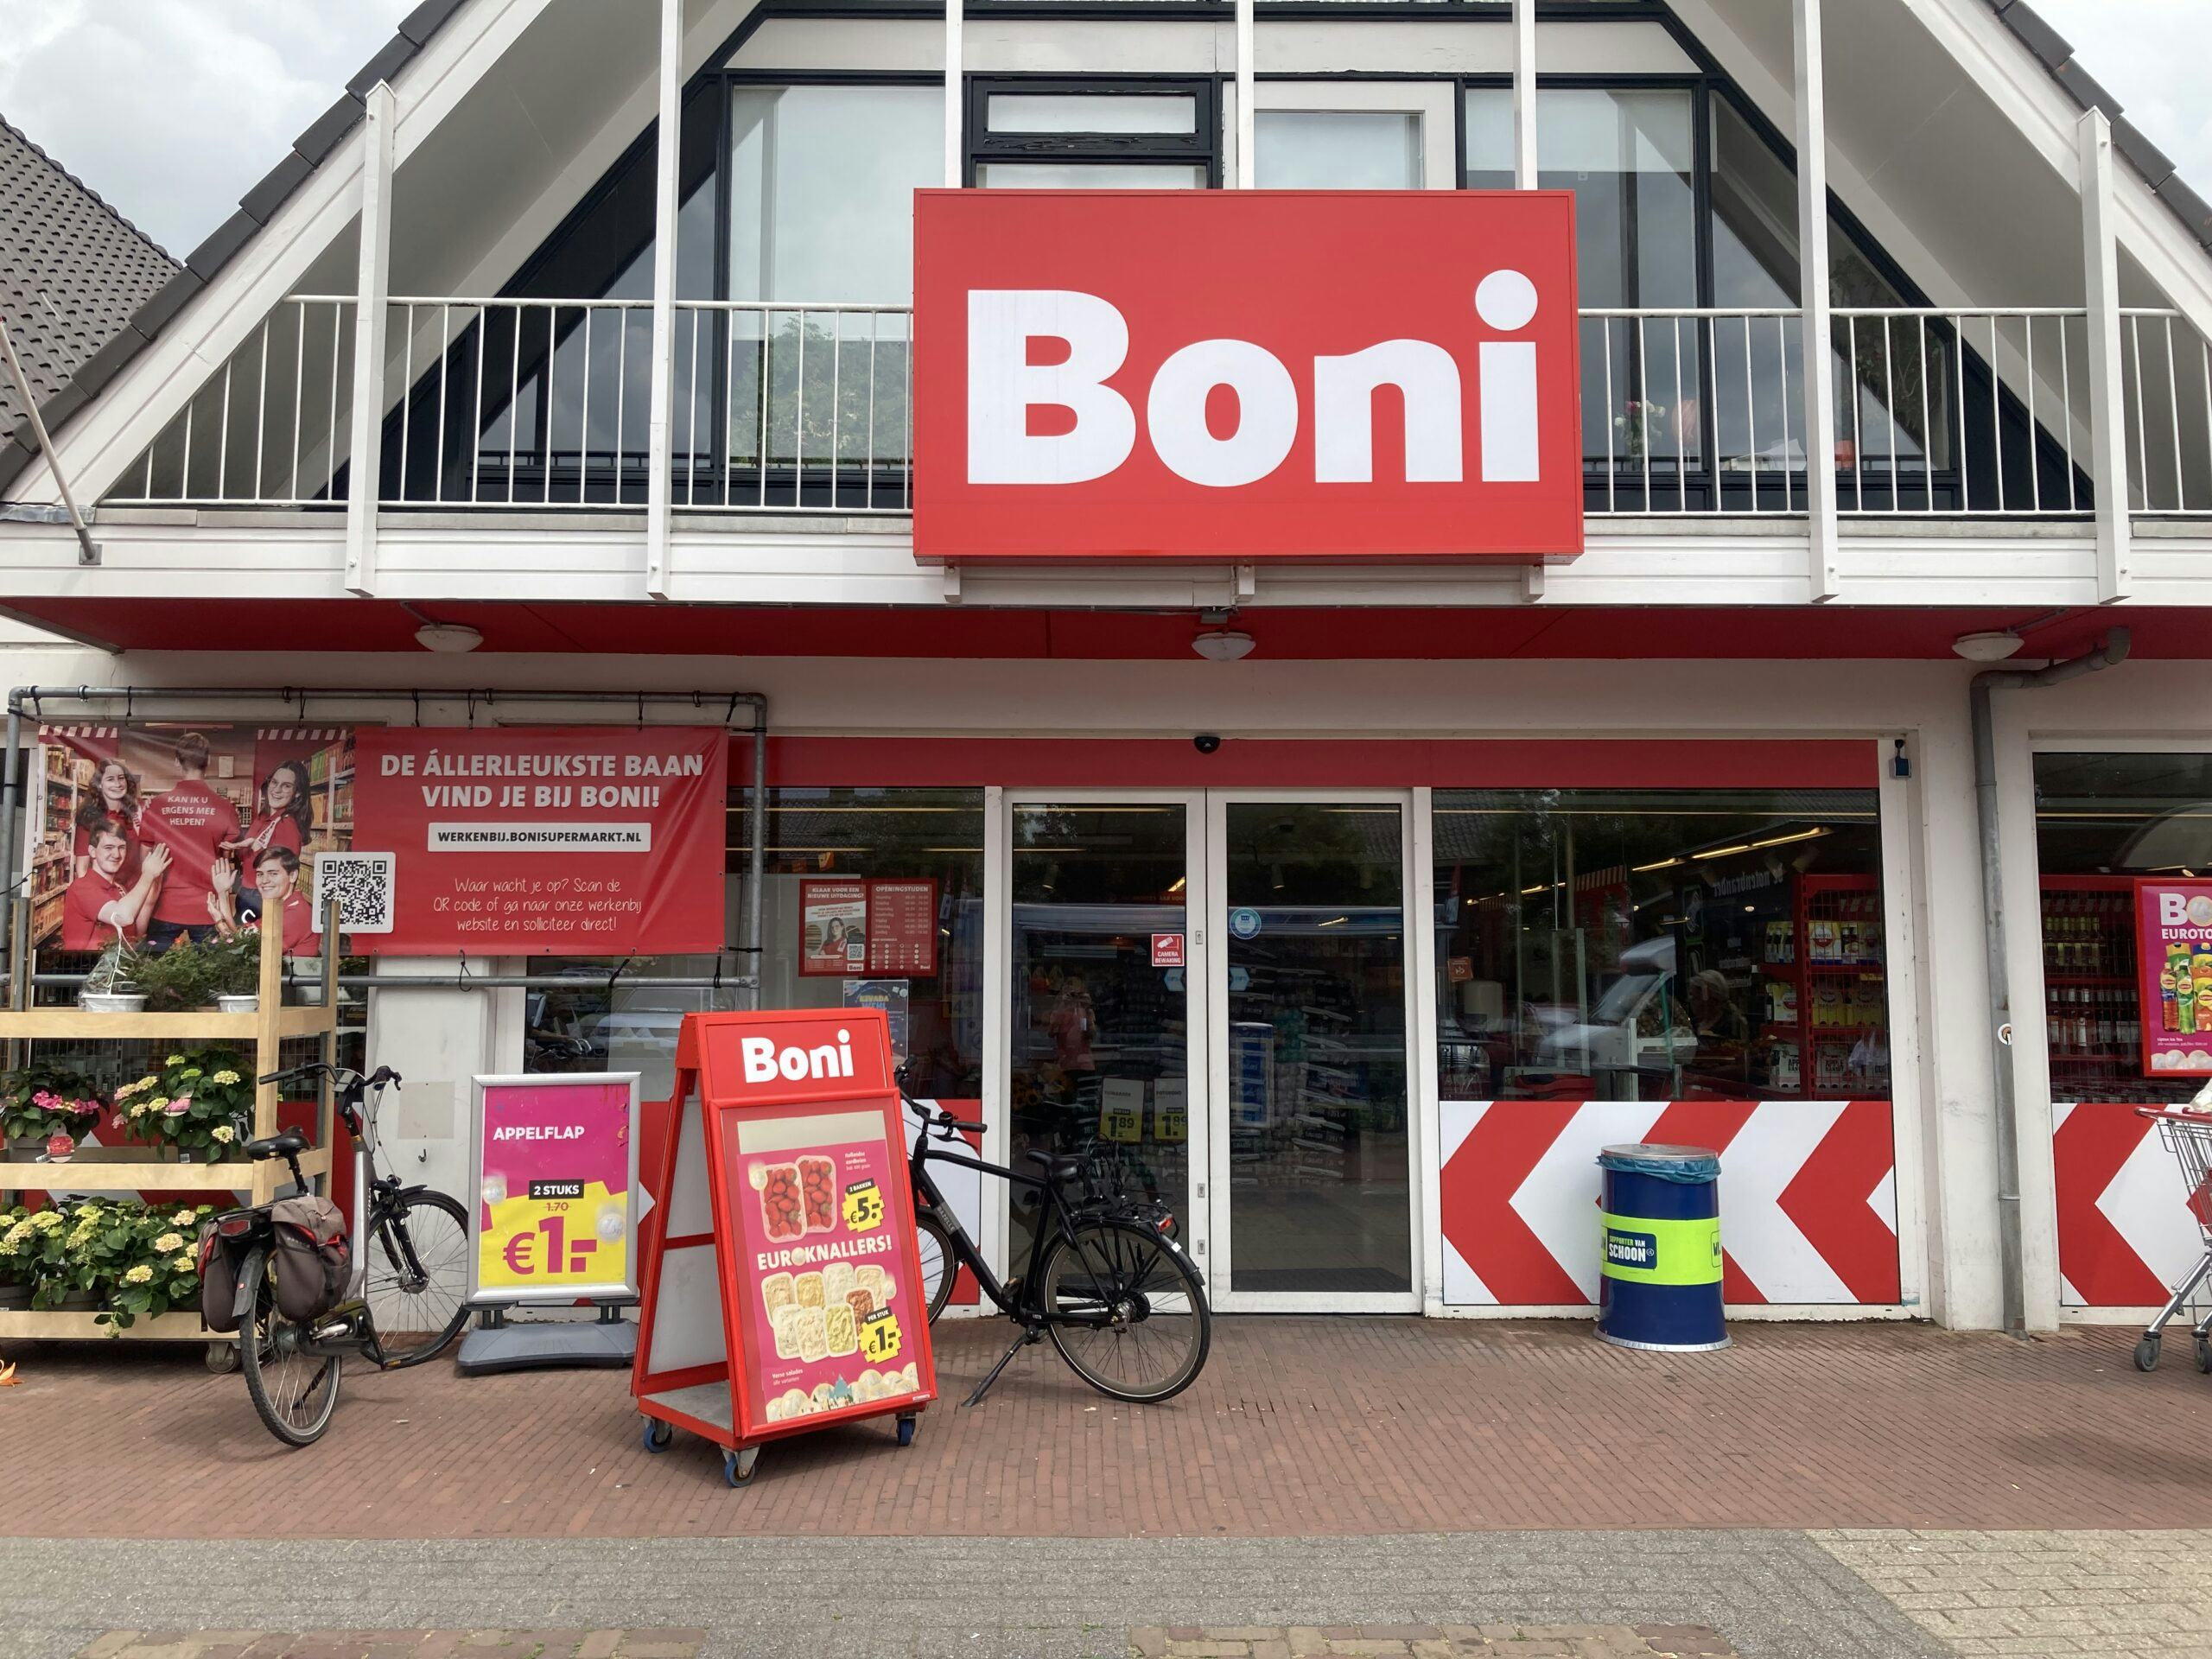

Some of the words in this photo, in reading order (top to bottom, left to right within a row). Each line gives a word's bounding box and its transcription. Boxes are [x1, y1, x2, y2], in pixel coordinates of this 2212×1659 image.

[967, 269, 1540, 487] Boni
[381, 754, 415, 776] DE
[422, 748, 616, 777] ÁLLERLEUKSTE
[625, 754, 703, 777] BAAN
[168, 795, 188, 804] KAN
[422, 785, 493, 807] VIND
[499, 785, 526, 807] JE
[534, 785, 572, 808] BIJ
[581, 785, 660, 808] BONI!
[162, 806, 194, 815] ERGENS
[195, 807, 216, 816] MEE
[169, 817, 206, 826] HELPEN?
[438, 832, 641, 842] WERKENBIJ.BONISUPERMARKT.NL
[454, 878, 488, 893] Waar
[493, 878, 527, 892] wacht
[530, 880, 542, 894] je
[547, 878, 569, 894] op?
[574, 878, 602, 893] Scan
[607, 878, 621, 892] de
[434, 897, 449, 912] QR
[454, 897, 480, 912] code
[486, 897, 499, 912] of
[504, 900, 518, 915] ga
[523, 899, 550, 912] naar
[555, 899, 584, 912] onze
[588, 898, 642, 913] werkenbij
[457, 917, 499, 931] website
[505, 919, 518, 931] en
[523, 917, 576, 931] solliciteer
[581, 917, 617, 931] direct!
[741, 1028, 855, 1084] Boni
[493, 1126, 585, 1141] APPELFLAP
[534, 1185, 540, 1195] 2
[543, 1185, 580, 1195] STUKS
[853, 1181, 872, 1191] BAKKEN
[546, 1202, 569, 1211] 1.70
[1609, 1236, 1634, 1247] SUPPORTER
[757, 1234, 893, 1271] EUROKNALLERS!
[1609, 1243, 1646, 1262] SCHOON
[877, 1309, 890, 1318] STUK
